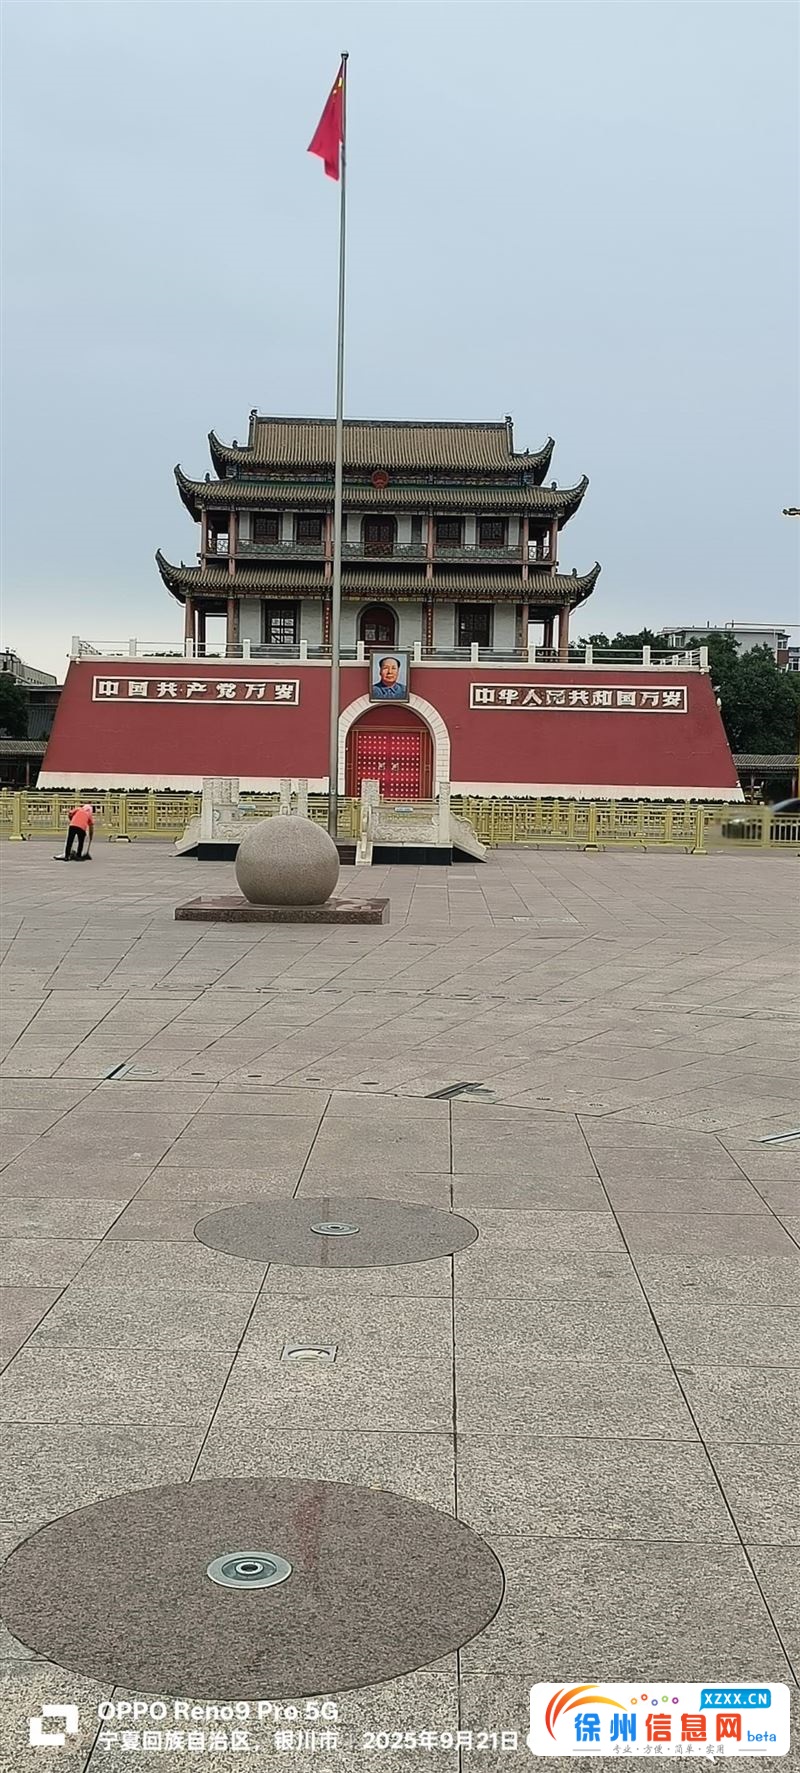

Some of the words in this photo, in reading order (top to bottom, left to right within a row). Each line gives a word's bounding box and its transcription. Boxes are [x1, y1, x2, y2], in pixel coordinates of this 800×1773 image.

[98, 680, 294, 700] 中国共产党万岁
[475, 688, 683, 707] 中华人民共和国万岁
